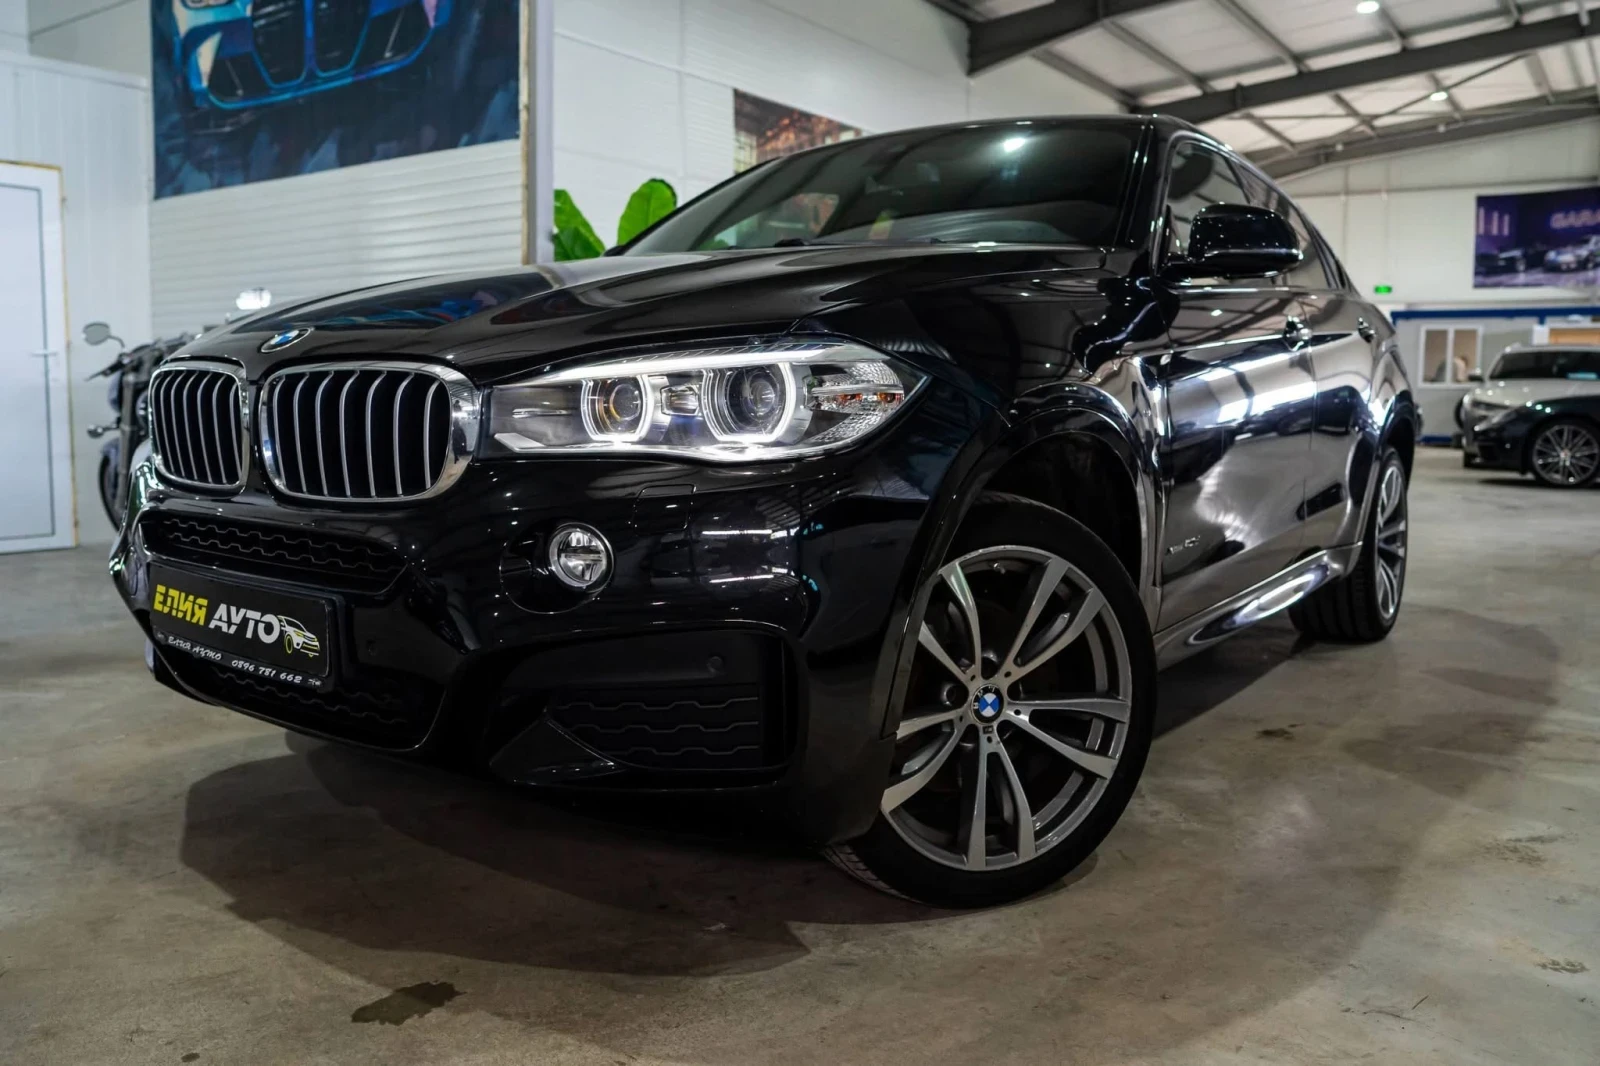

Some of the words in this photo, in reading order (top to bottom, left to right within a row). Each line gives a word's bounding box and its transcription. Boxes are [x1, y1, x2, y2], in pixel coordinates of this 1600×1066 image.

[153, 584, 208, 625] ЕЛИЯ
[208, 603, 280, 644] АУТО
[231, 659, 255, 673] 0896
[258, 665, 277, 678] 781
[279, 671, 303, 683] 662
